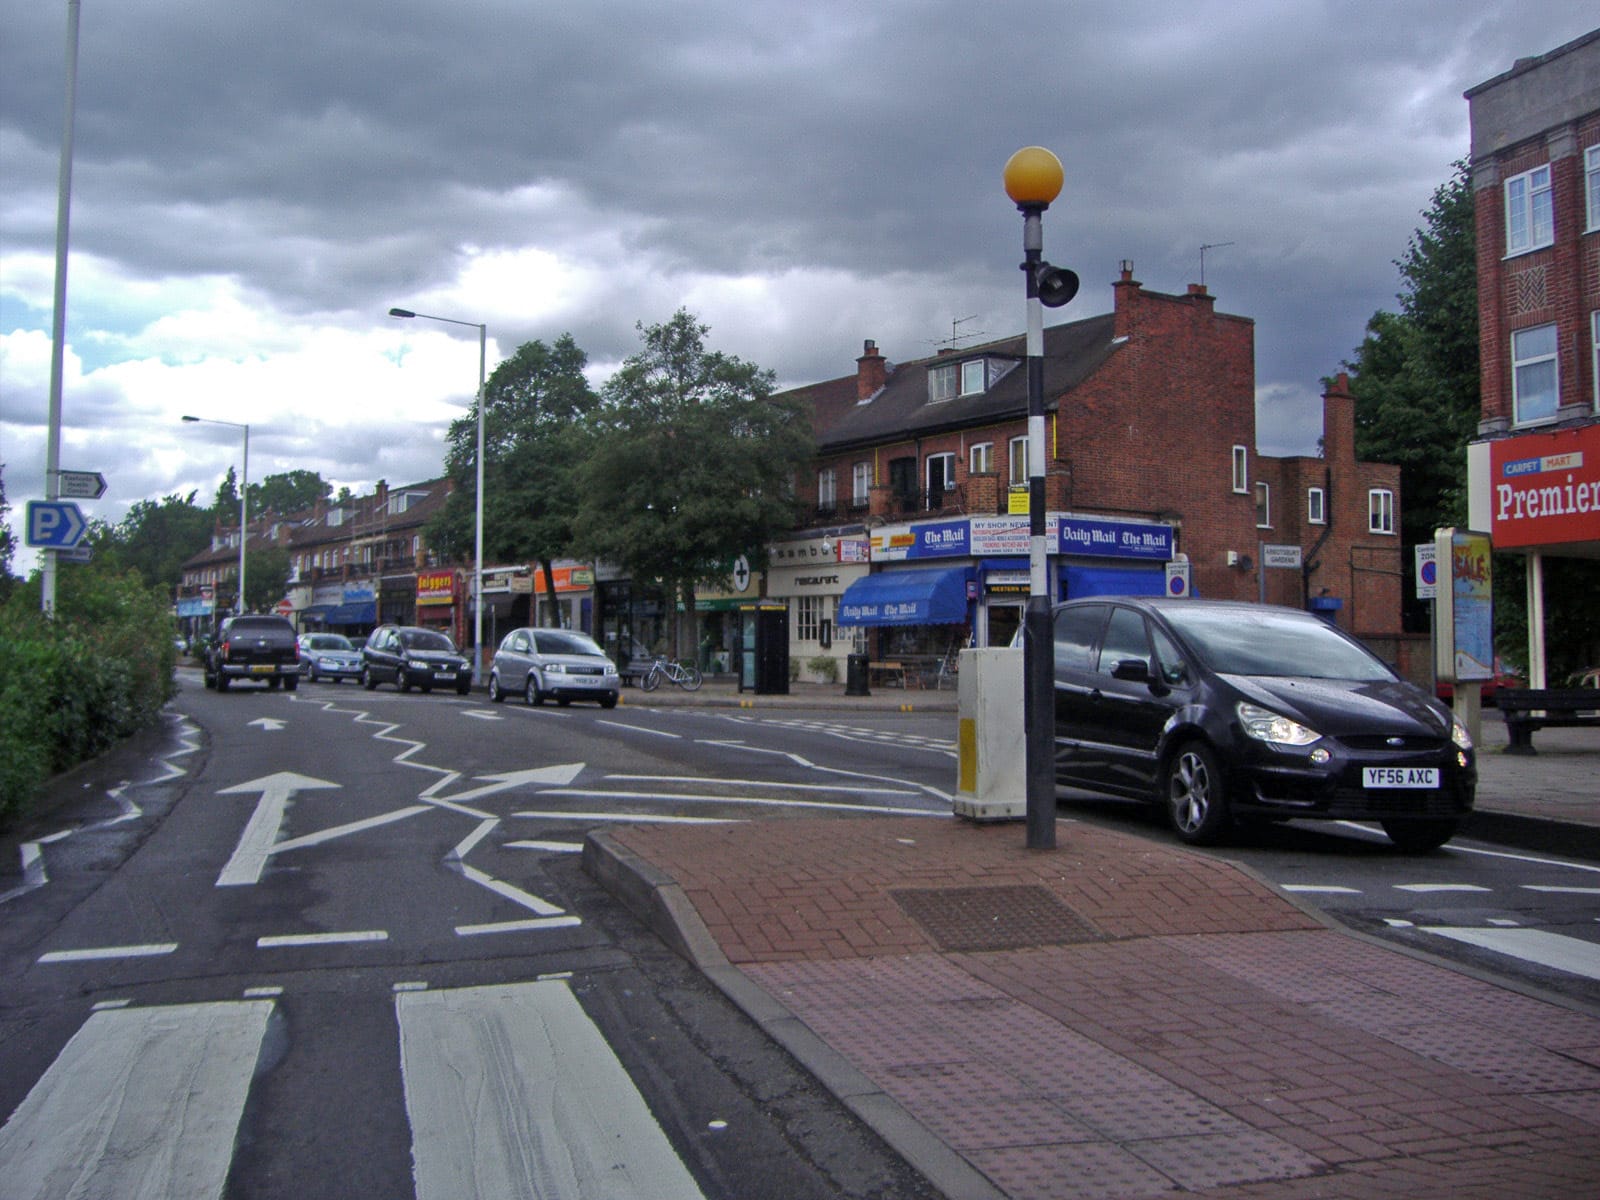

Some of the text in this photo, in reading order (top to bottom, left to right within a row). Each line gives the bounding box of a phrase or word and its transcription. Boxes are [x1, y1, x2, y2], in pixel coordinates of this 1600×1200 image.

[1505, 456, 1571, 474] CARPET MART
[33, 507, 60, 540] P
[924, 530, 941, 544] The
[942, 527, 964, 542] Mail
[1063, 527, 1090, 546] Daily
[1092, 529, 1116, 543] Mail
[1122, 532, 1141, 544] The
[1142, 533, 1166, 546] Mail
[795, 575, 838, 585] restaurant
[861, 605, 878, 616] Mail
[884, 602, 916, 615] The Mail
[1369, 769, 1433, 784] YF56 AXC
